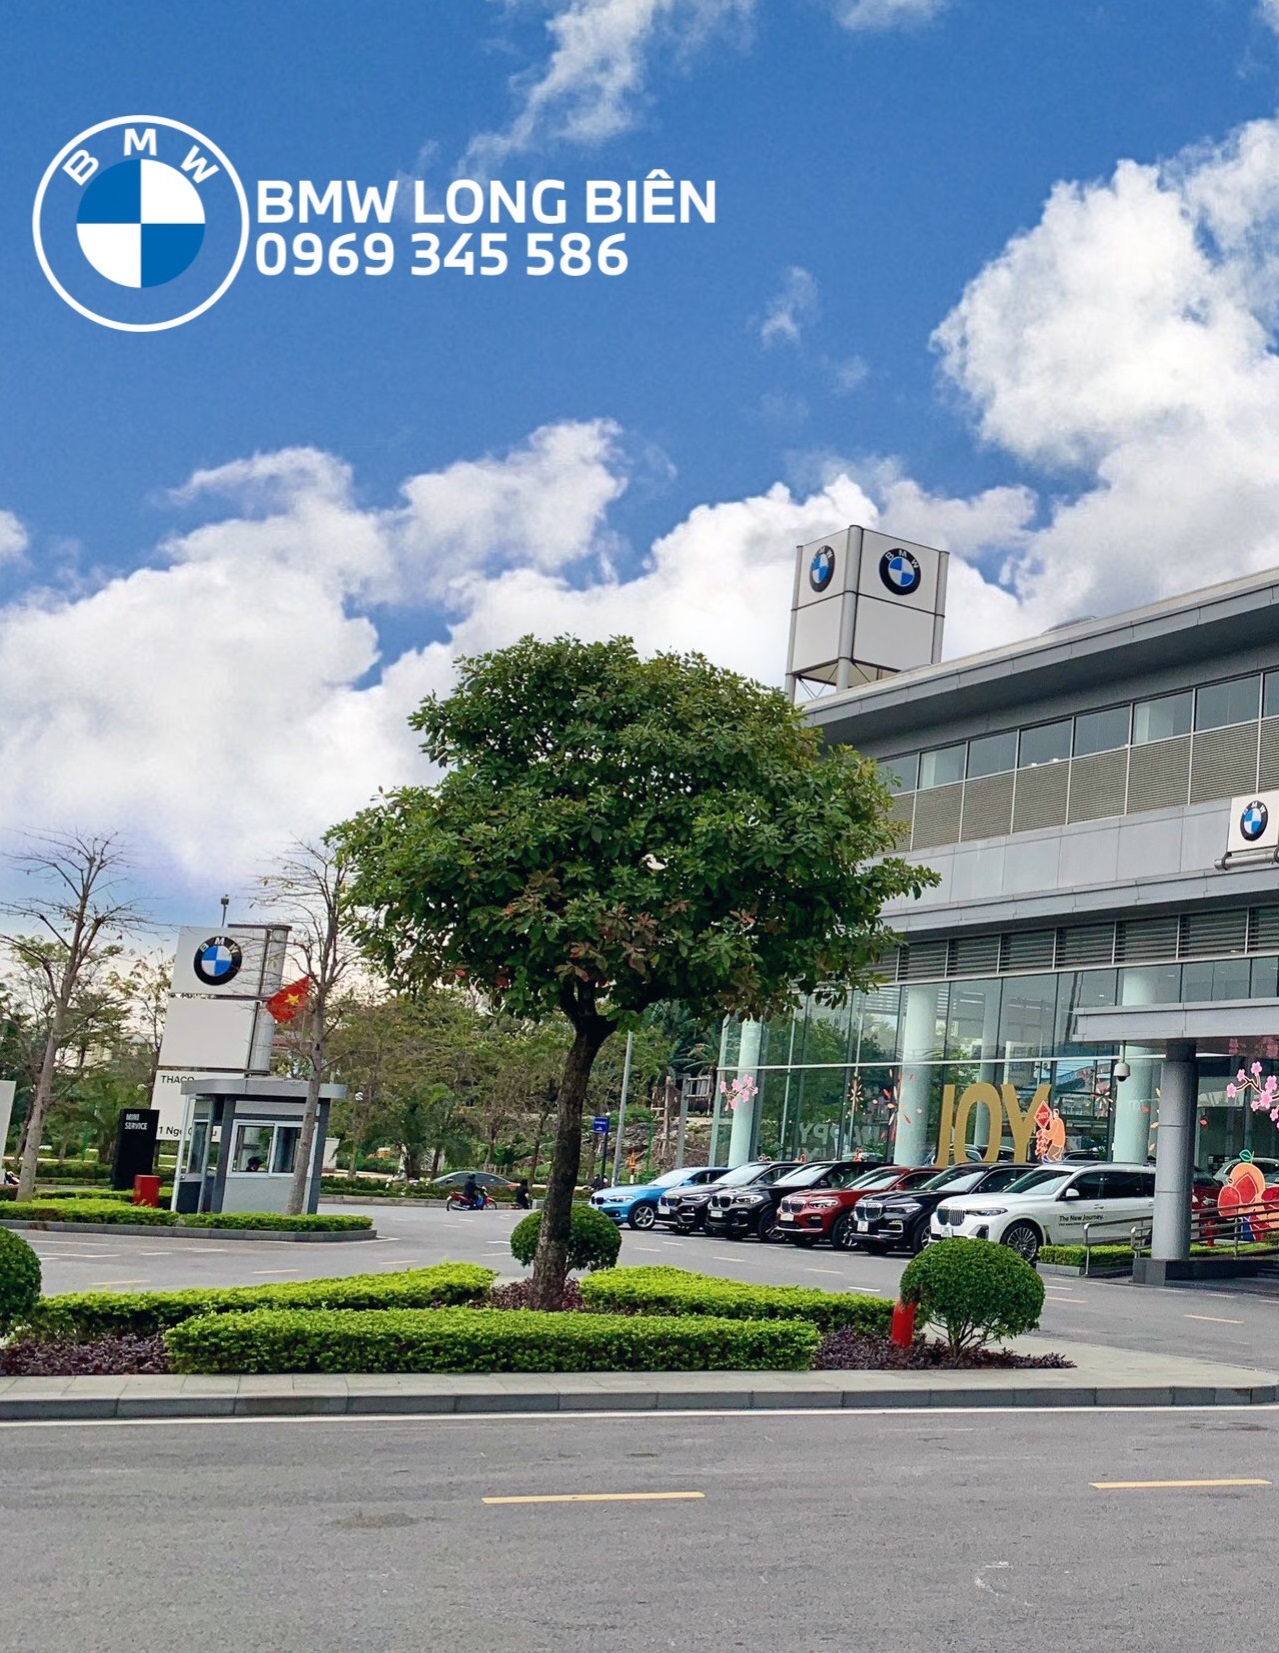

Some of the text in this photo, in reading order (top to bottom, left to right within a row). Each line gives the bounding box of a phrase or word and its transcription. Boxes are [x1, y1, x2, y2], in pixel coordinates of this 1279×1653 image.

[885, 549, 920, 568] BMW
[200, 937, 240, 953] BMW
[124, 1121, 148, 1130] SERVICE
[934, 1082, 1052, 1168] JOY
